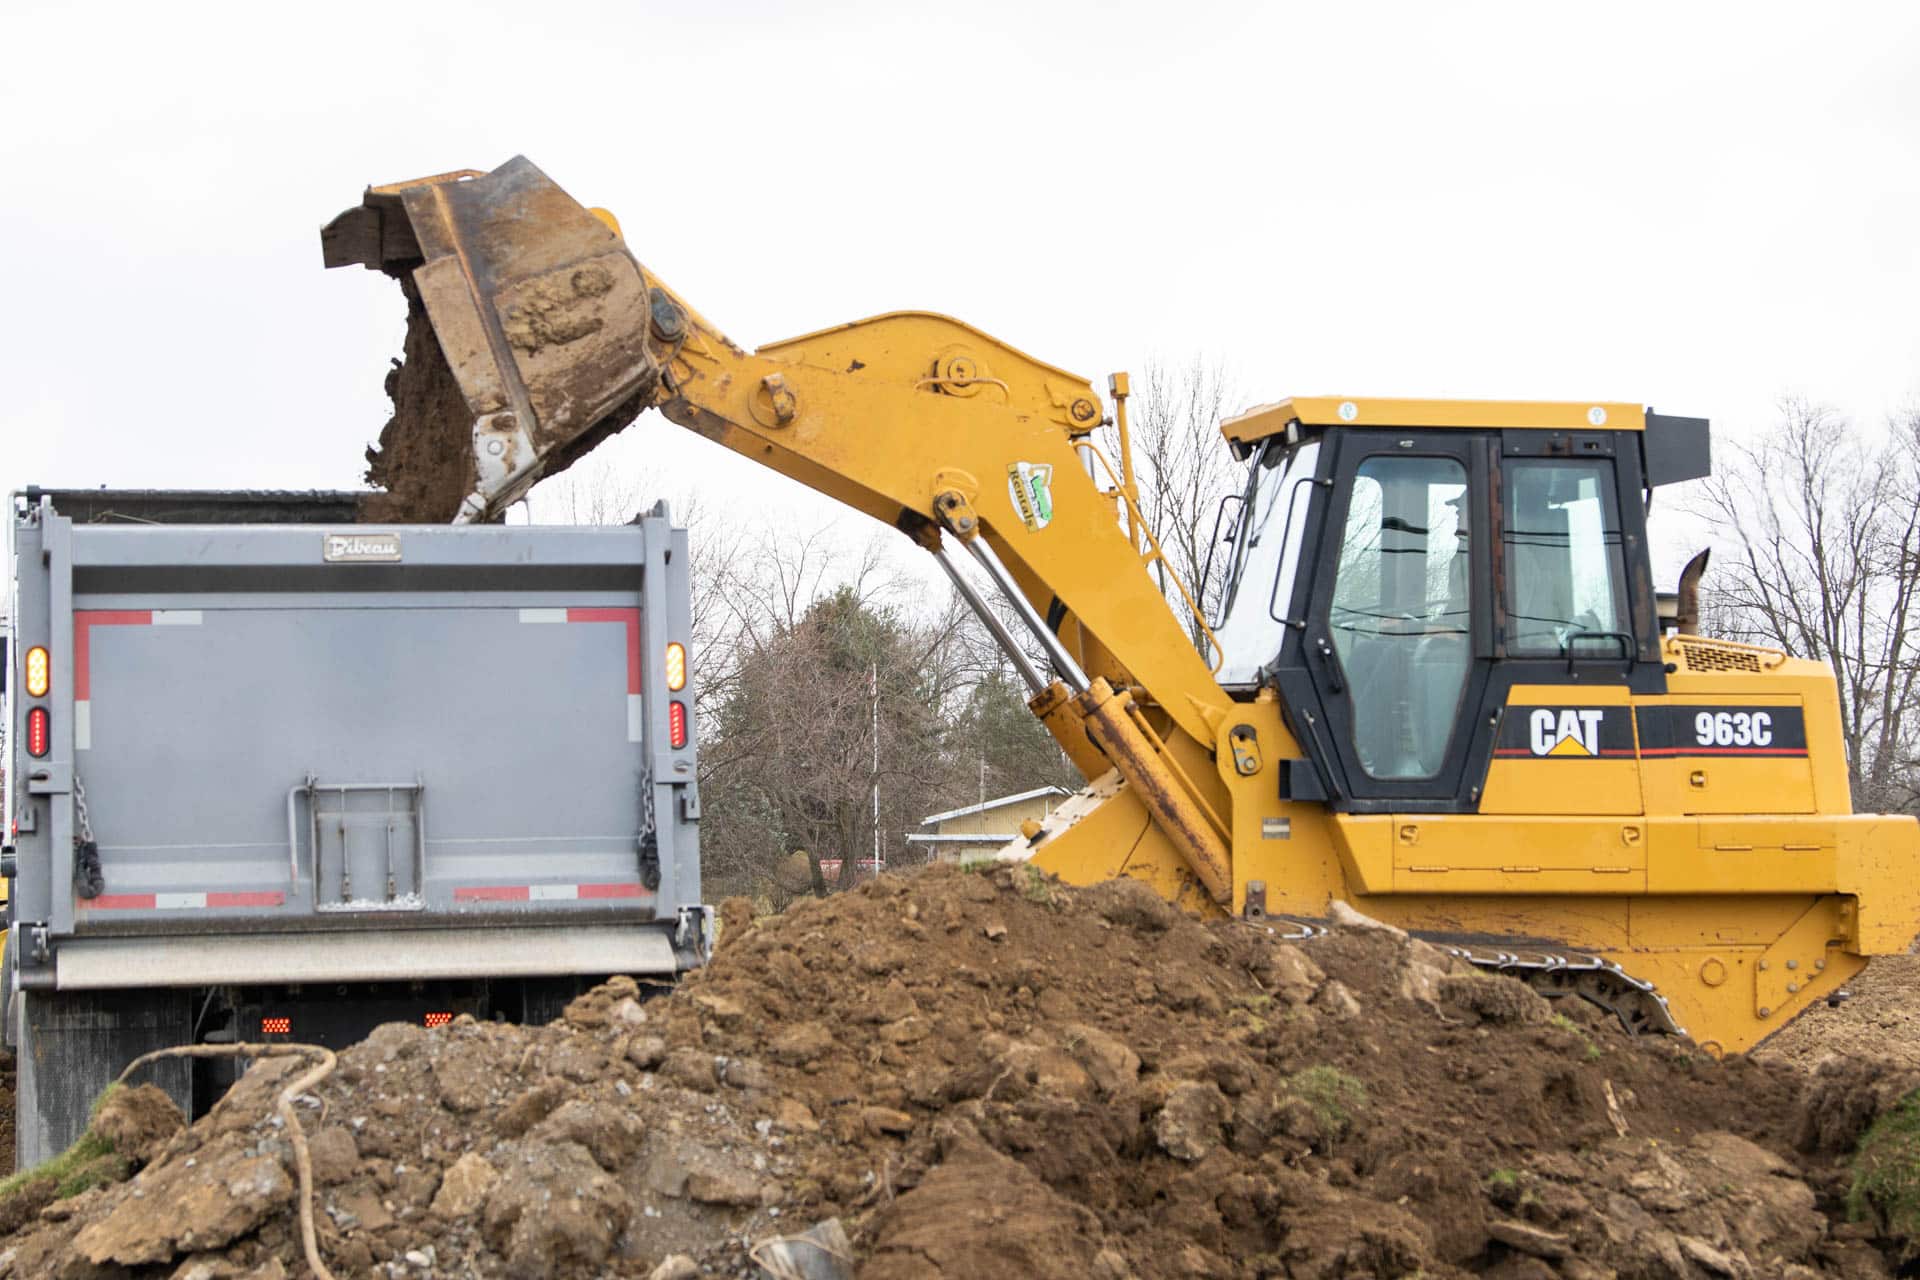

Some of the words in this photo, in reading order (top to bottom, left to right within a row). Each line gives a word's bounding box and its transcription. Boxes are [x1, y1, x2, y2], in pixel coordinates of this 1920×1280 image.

[1010, 471, 1034, 526] Rentals
[1530, 709, 1604, 756] CAT
[1695, 712, 1772, 746] 963C
